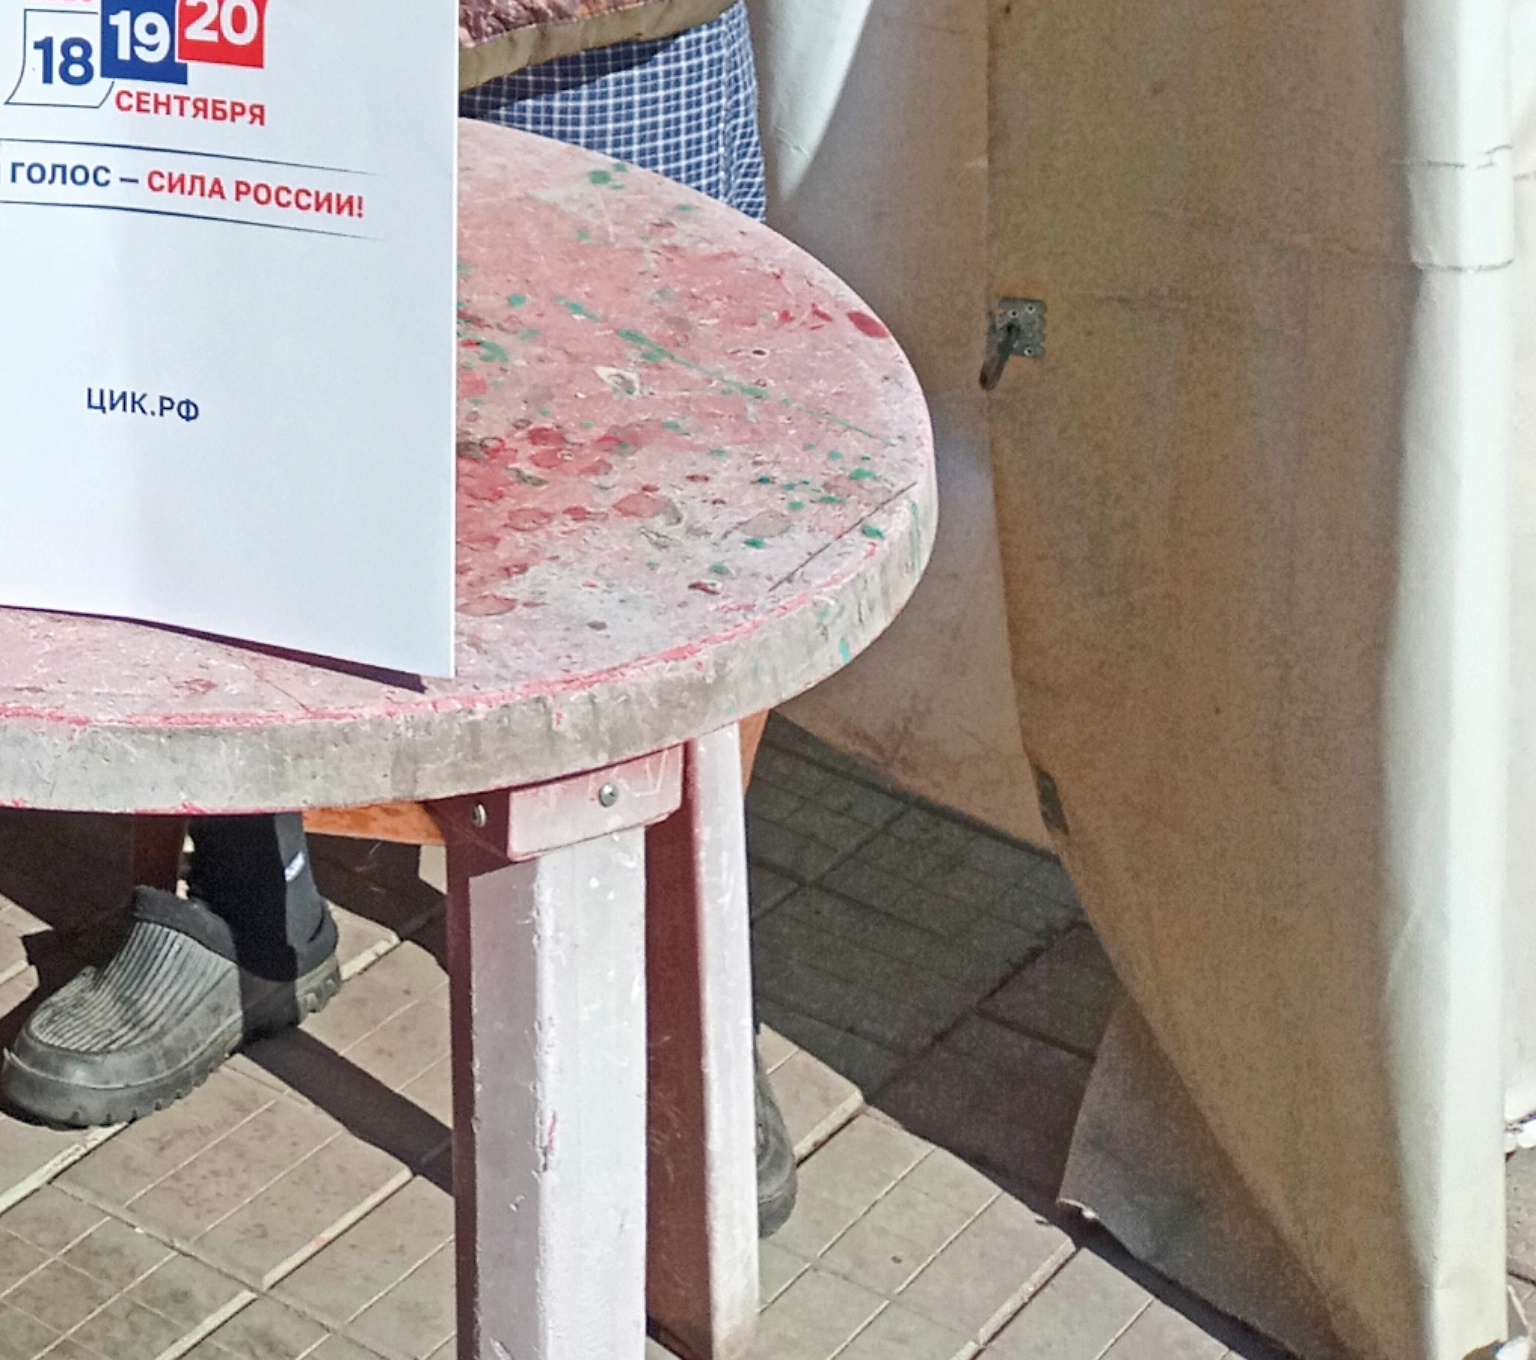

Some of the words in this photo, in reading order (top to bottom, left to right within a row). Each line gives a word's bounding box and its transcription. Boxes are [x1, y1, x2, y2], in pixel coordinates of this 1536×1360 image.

[32, 35, 95, 87] 18
[109, 11, 171, 63] 19
[115, 90, 266, 127] СЕНТЯБРЯ
[10, 162, 112, 188] ГОЛОС
[147, 170, 227, 201] СИЛА
[235, 180, 365, 219] РОССИИ!
[86, 387, 200, 422] ЦИК.РФ
